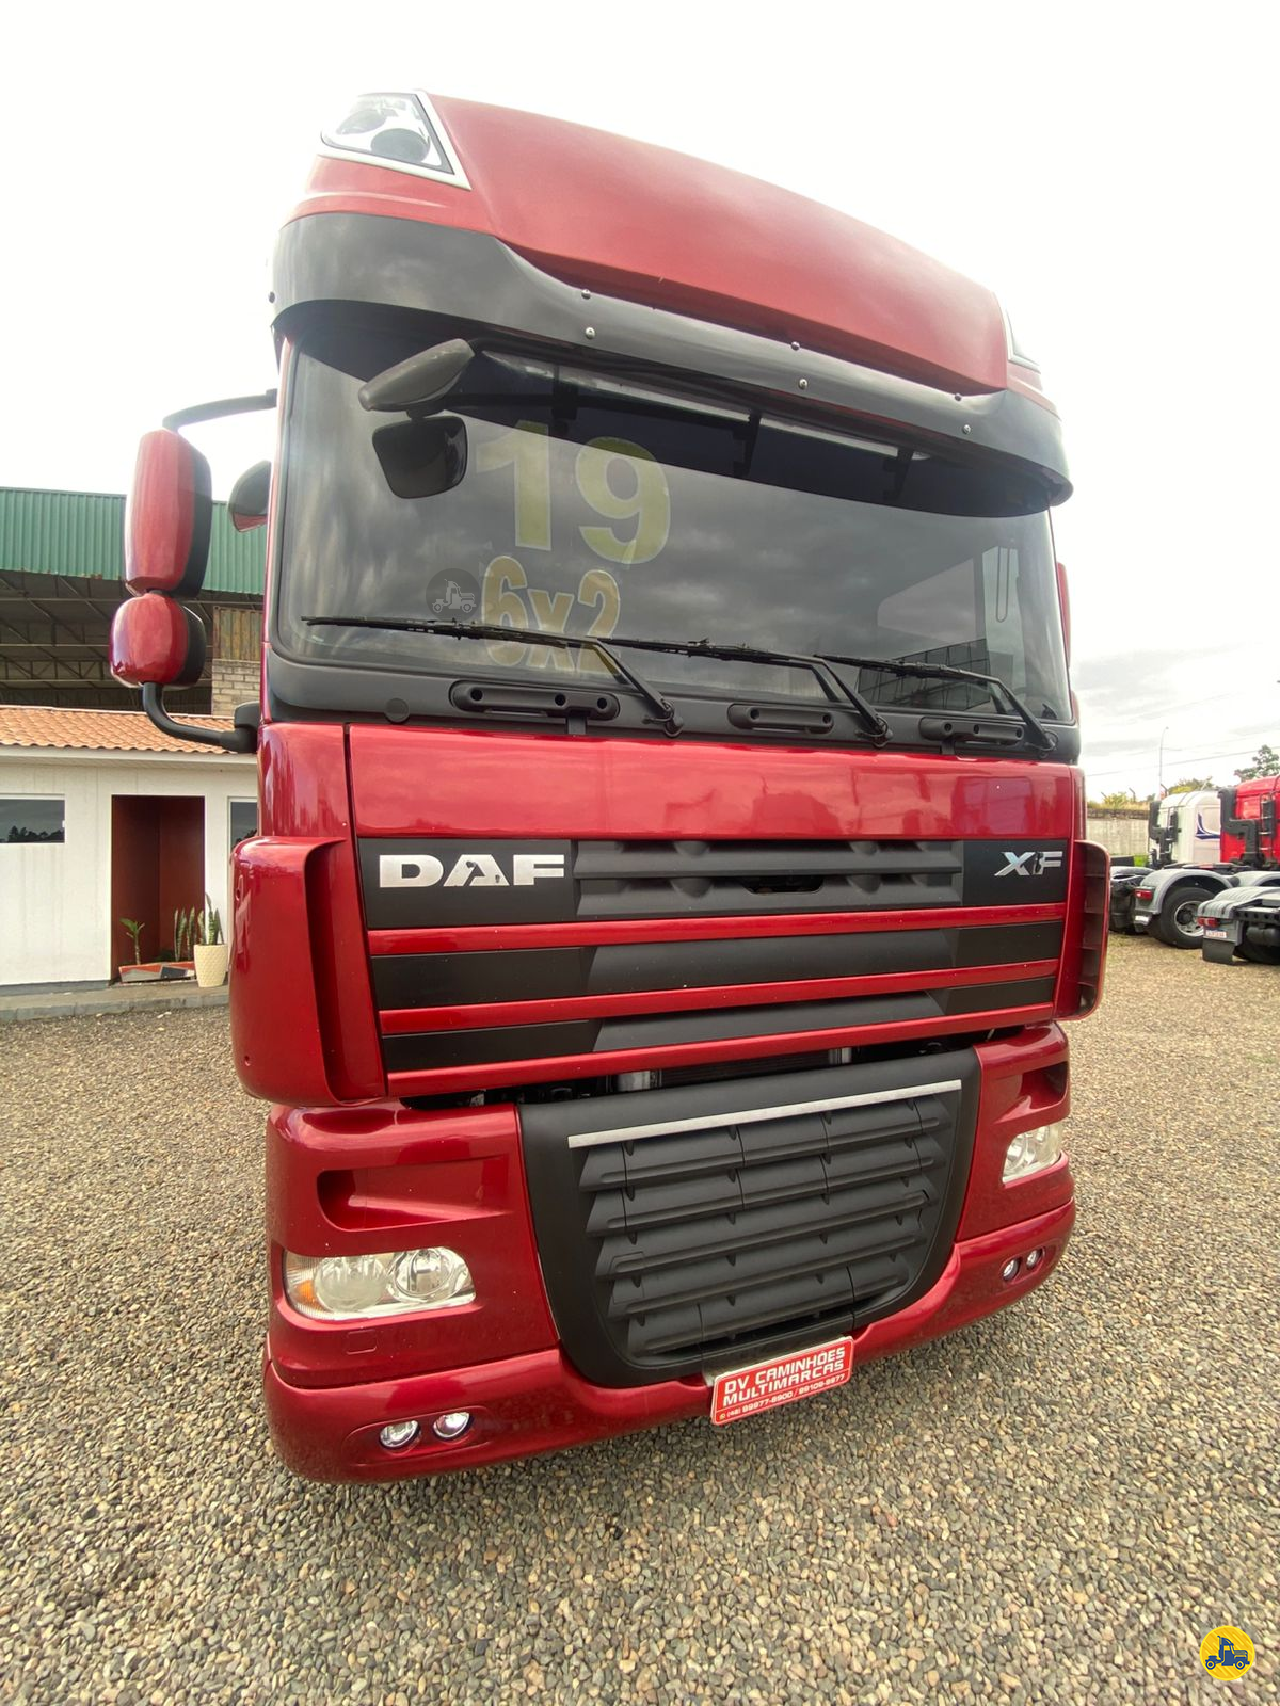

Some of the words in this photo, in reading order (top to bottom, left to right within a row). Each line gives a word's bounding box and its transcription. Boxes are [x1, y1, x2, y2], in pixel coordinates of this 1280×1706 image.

[476, 420, 671, 564] 19
[481, 556, 621, 676] 6x2
[379, 854, 565, 888] DAF
[994, 851, 1063, 876] XF
[722, 1358, 845, 1407] MULTIMARCAS
[724, 1374, 750, 1395] DV
